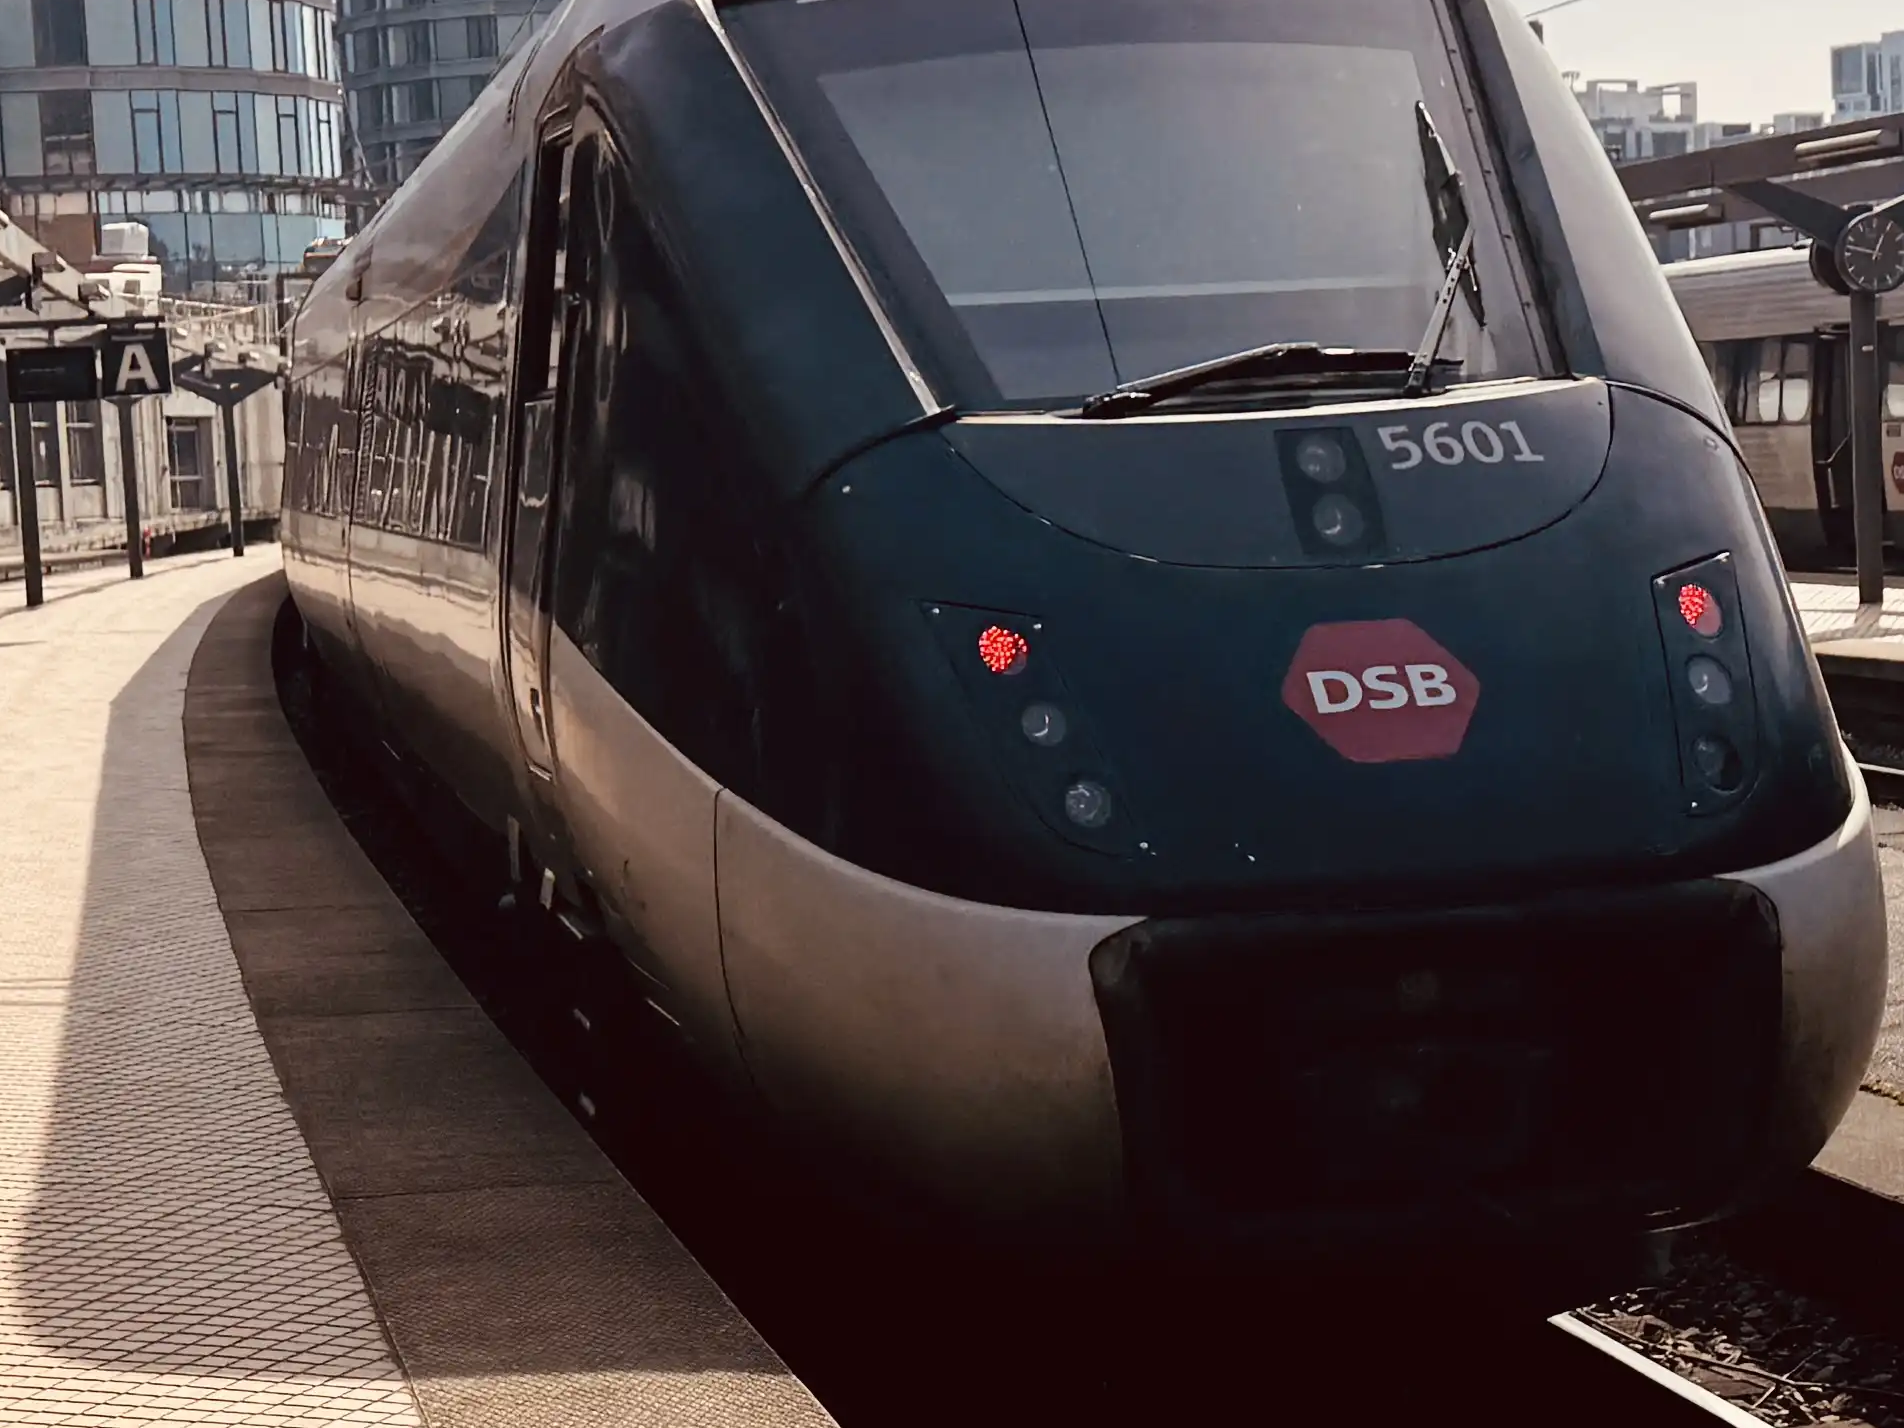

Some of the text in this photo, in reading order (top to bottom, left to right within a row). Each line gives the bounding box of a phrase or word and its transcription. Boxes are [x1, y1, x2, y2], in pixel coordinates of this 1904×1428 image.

[115, 343, 160, 392] A
[1377, 421, 1544, 470] 5601
[1306, 664, 1457, 714] DSB
